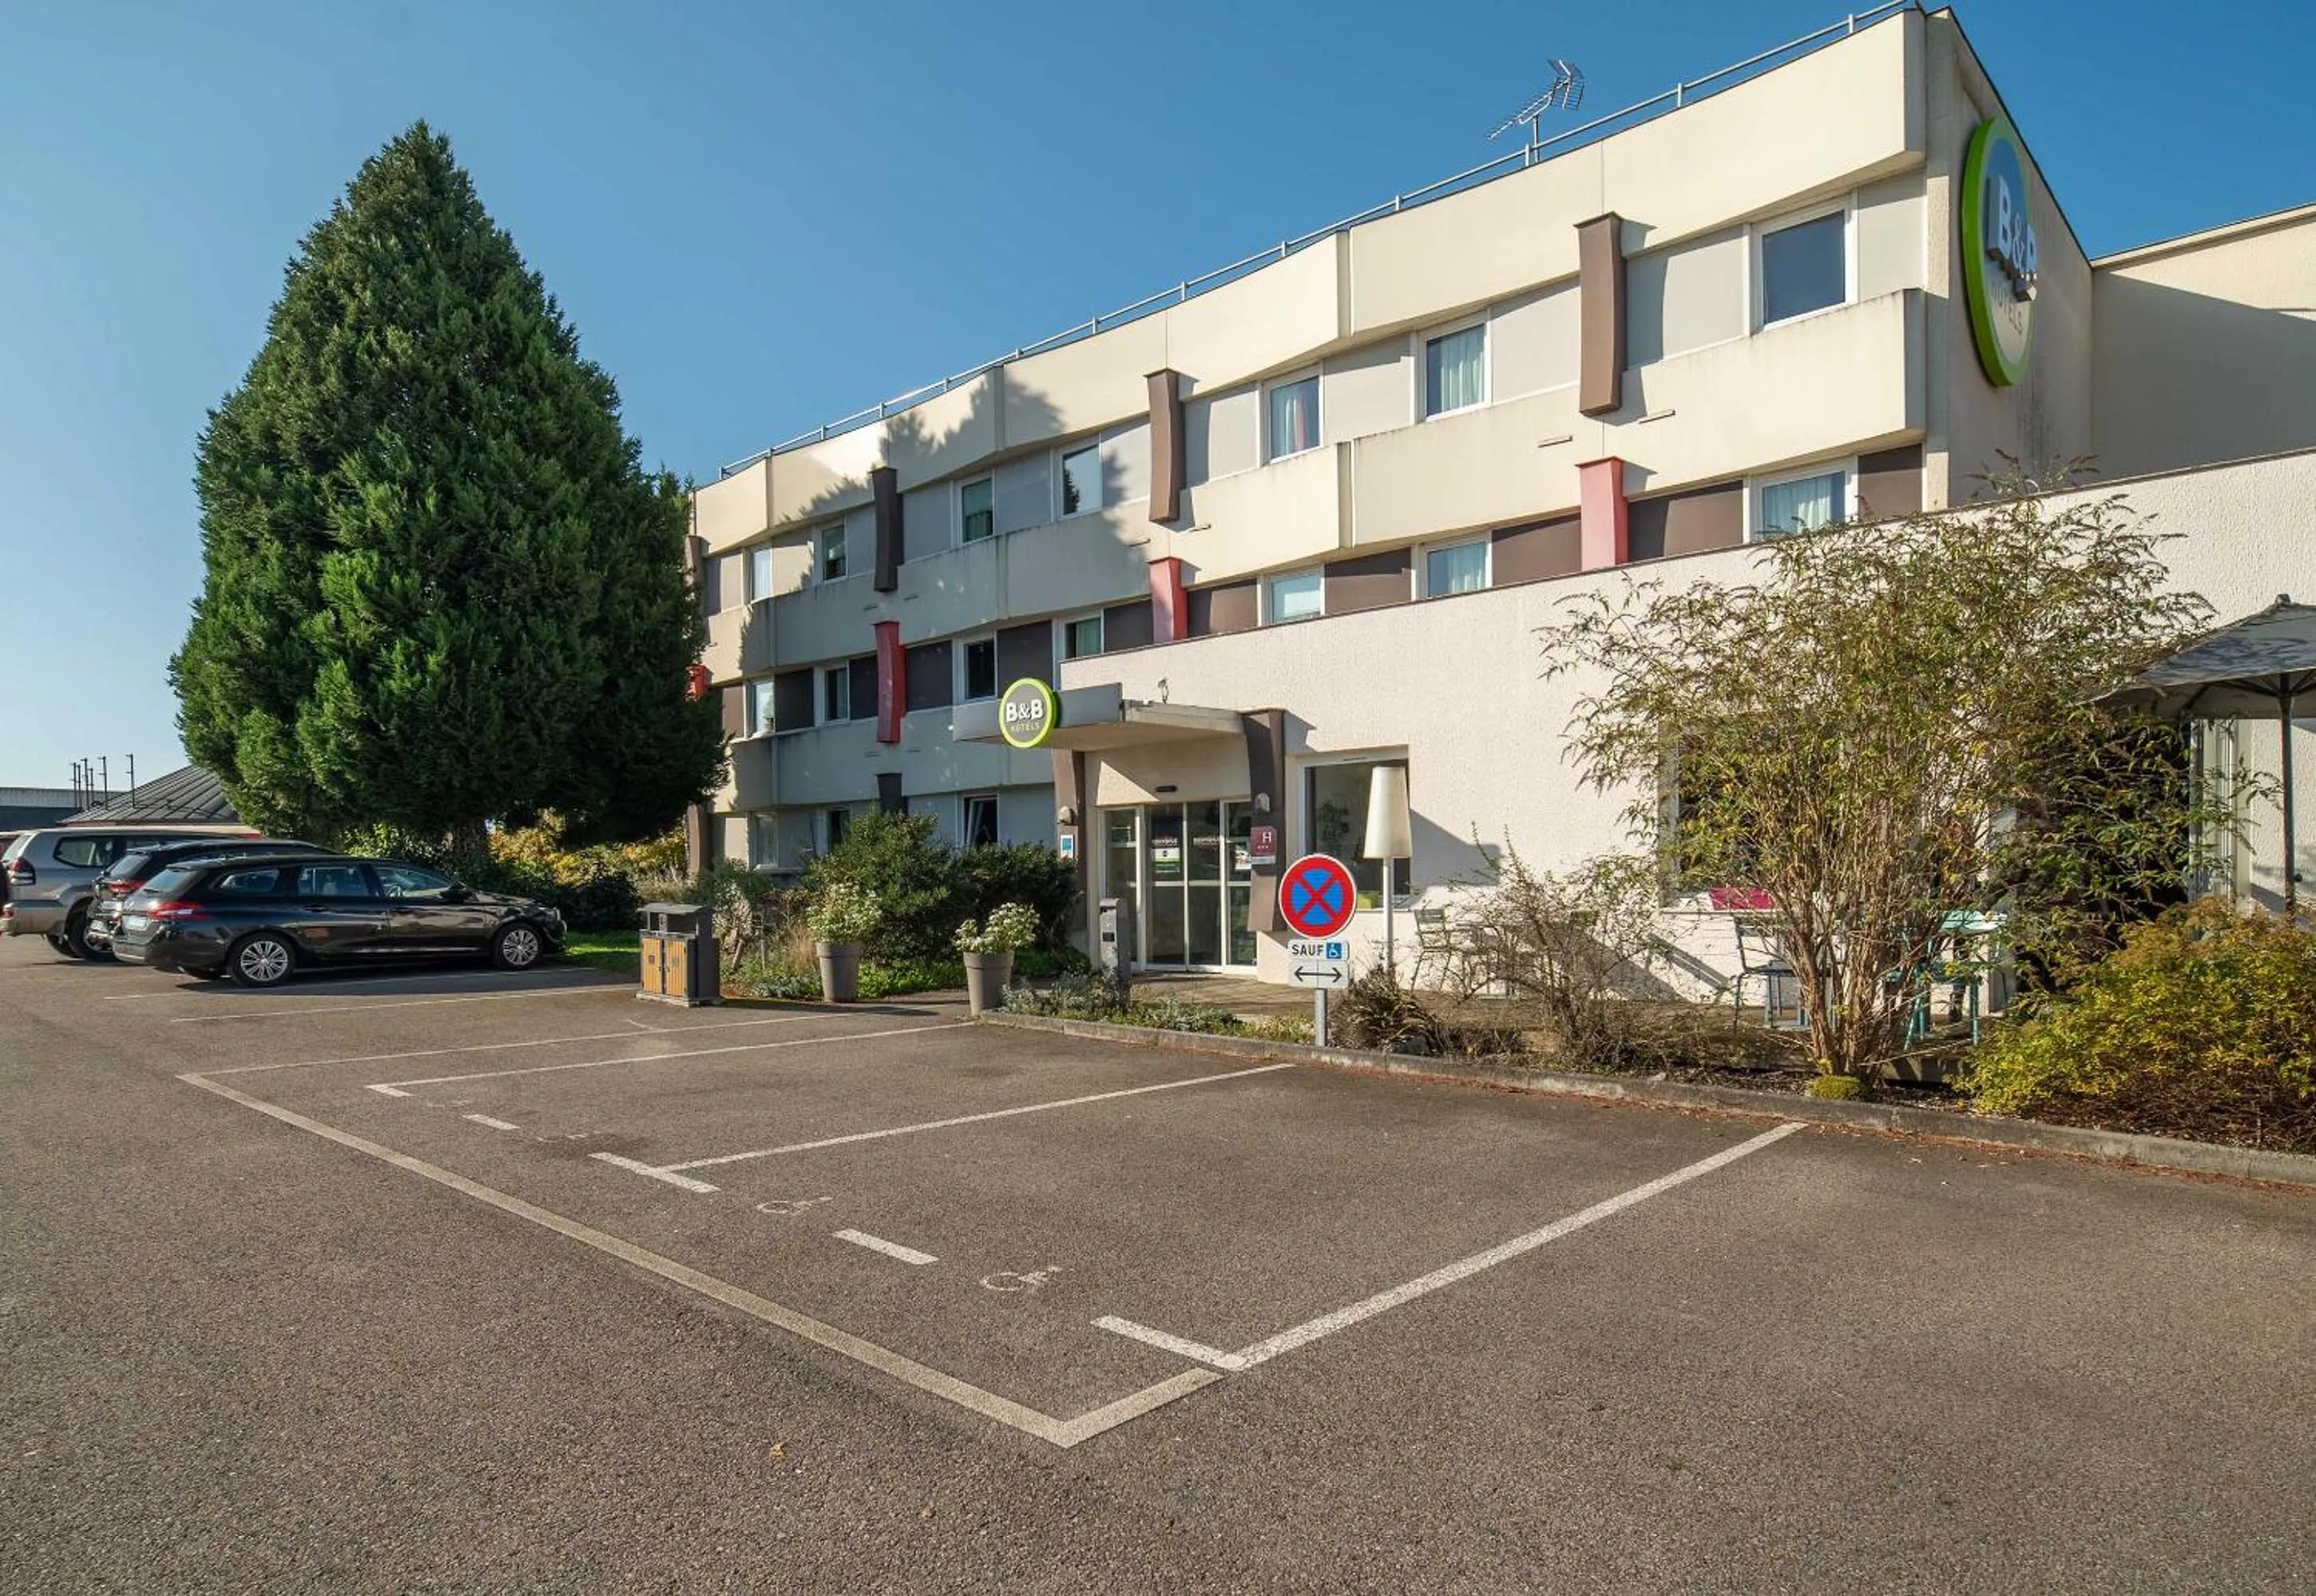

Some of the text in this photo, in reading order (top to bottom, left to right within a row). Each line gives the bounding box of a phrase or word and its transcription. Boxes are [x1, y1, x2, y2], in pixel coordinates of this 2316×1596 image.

[1988, 174, 2037, 302] B&B
[1006, 699, 1043, 723] B&B
[1263, 831, 1271, 843] H
[1291, 944, 1324, 956] SAUF
